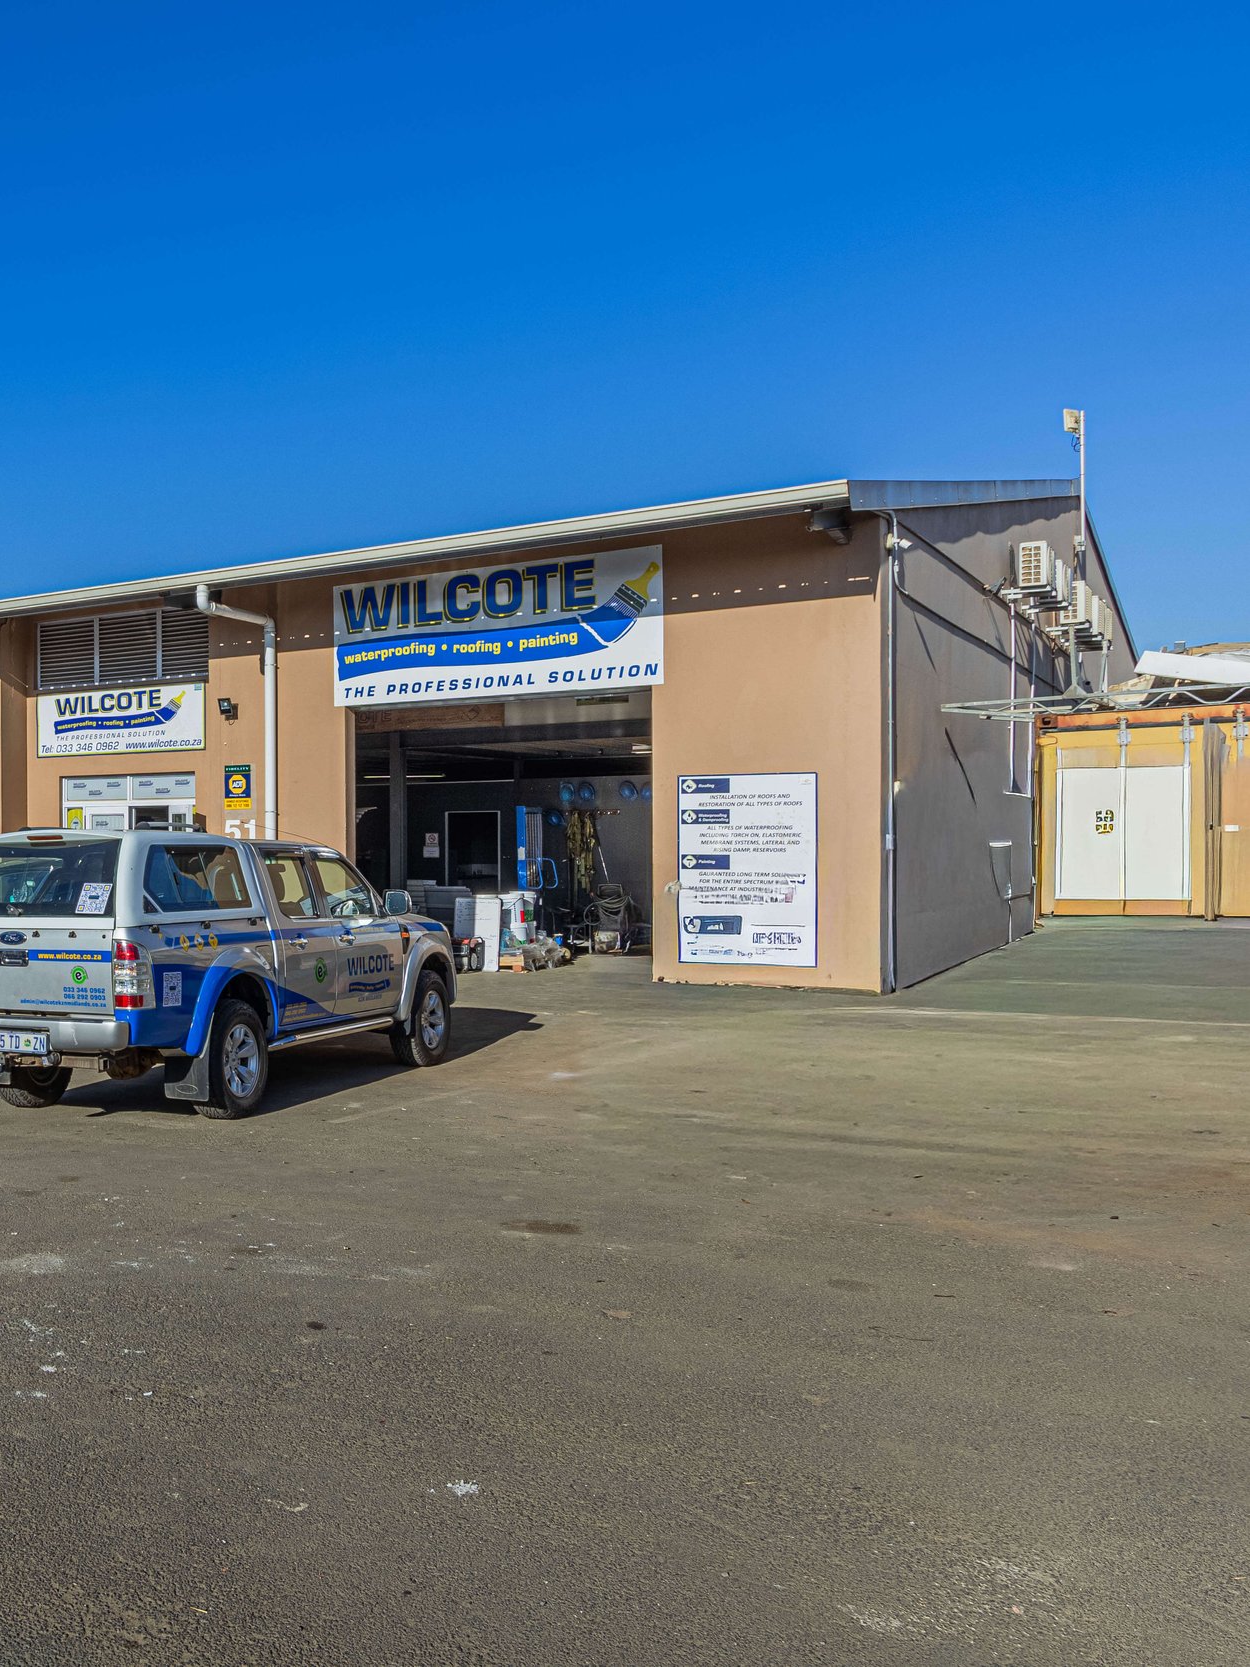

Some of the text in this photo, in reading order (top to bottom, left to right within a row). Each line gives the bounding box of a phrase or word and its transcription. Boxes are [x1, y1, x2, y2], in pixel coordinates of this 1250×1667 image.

[340, 559, 596, 634] WILCOTE
[344, 631, 578, 664] waterproofing roofing painting
[344, 663, 659, 699] THE PROFESSIONAL SOLUTION
[55, 689, 162, 717] WILCOTE
[57, 720, 97, 730] waterproofing
[131, 716, 155, 725] painting
[71, 732, 125, 741] PROFESSIONAL
[127, 730, 166, 738] SOLUTION
[56, 744, 73, 753] 033
[75, 742, 93, 752] 346
[96, 741, 120, 751] 0962
[125, 739, 203, 749] www.wilcote.co.za
[232, 780, 243, 788] ADT
[224, 819, 256, 840] 51
[37, 952, 102, 960] www.wilcote.co.za
[347, 954, 394, 976] WILCOTE
[9, 1035, 20, 1049] TD
[33, 1037, 45, 1051] ZN
